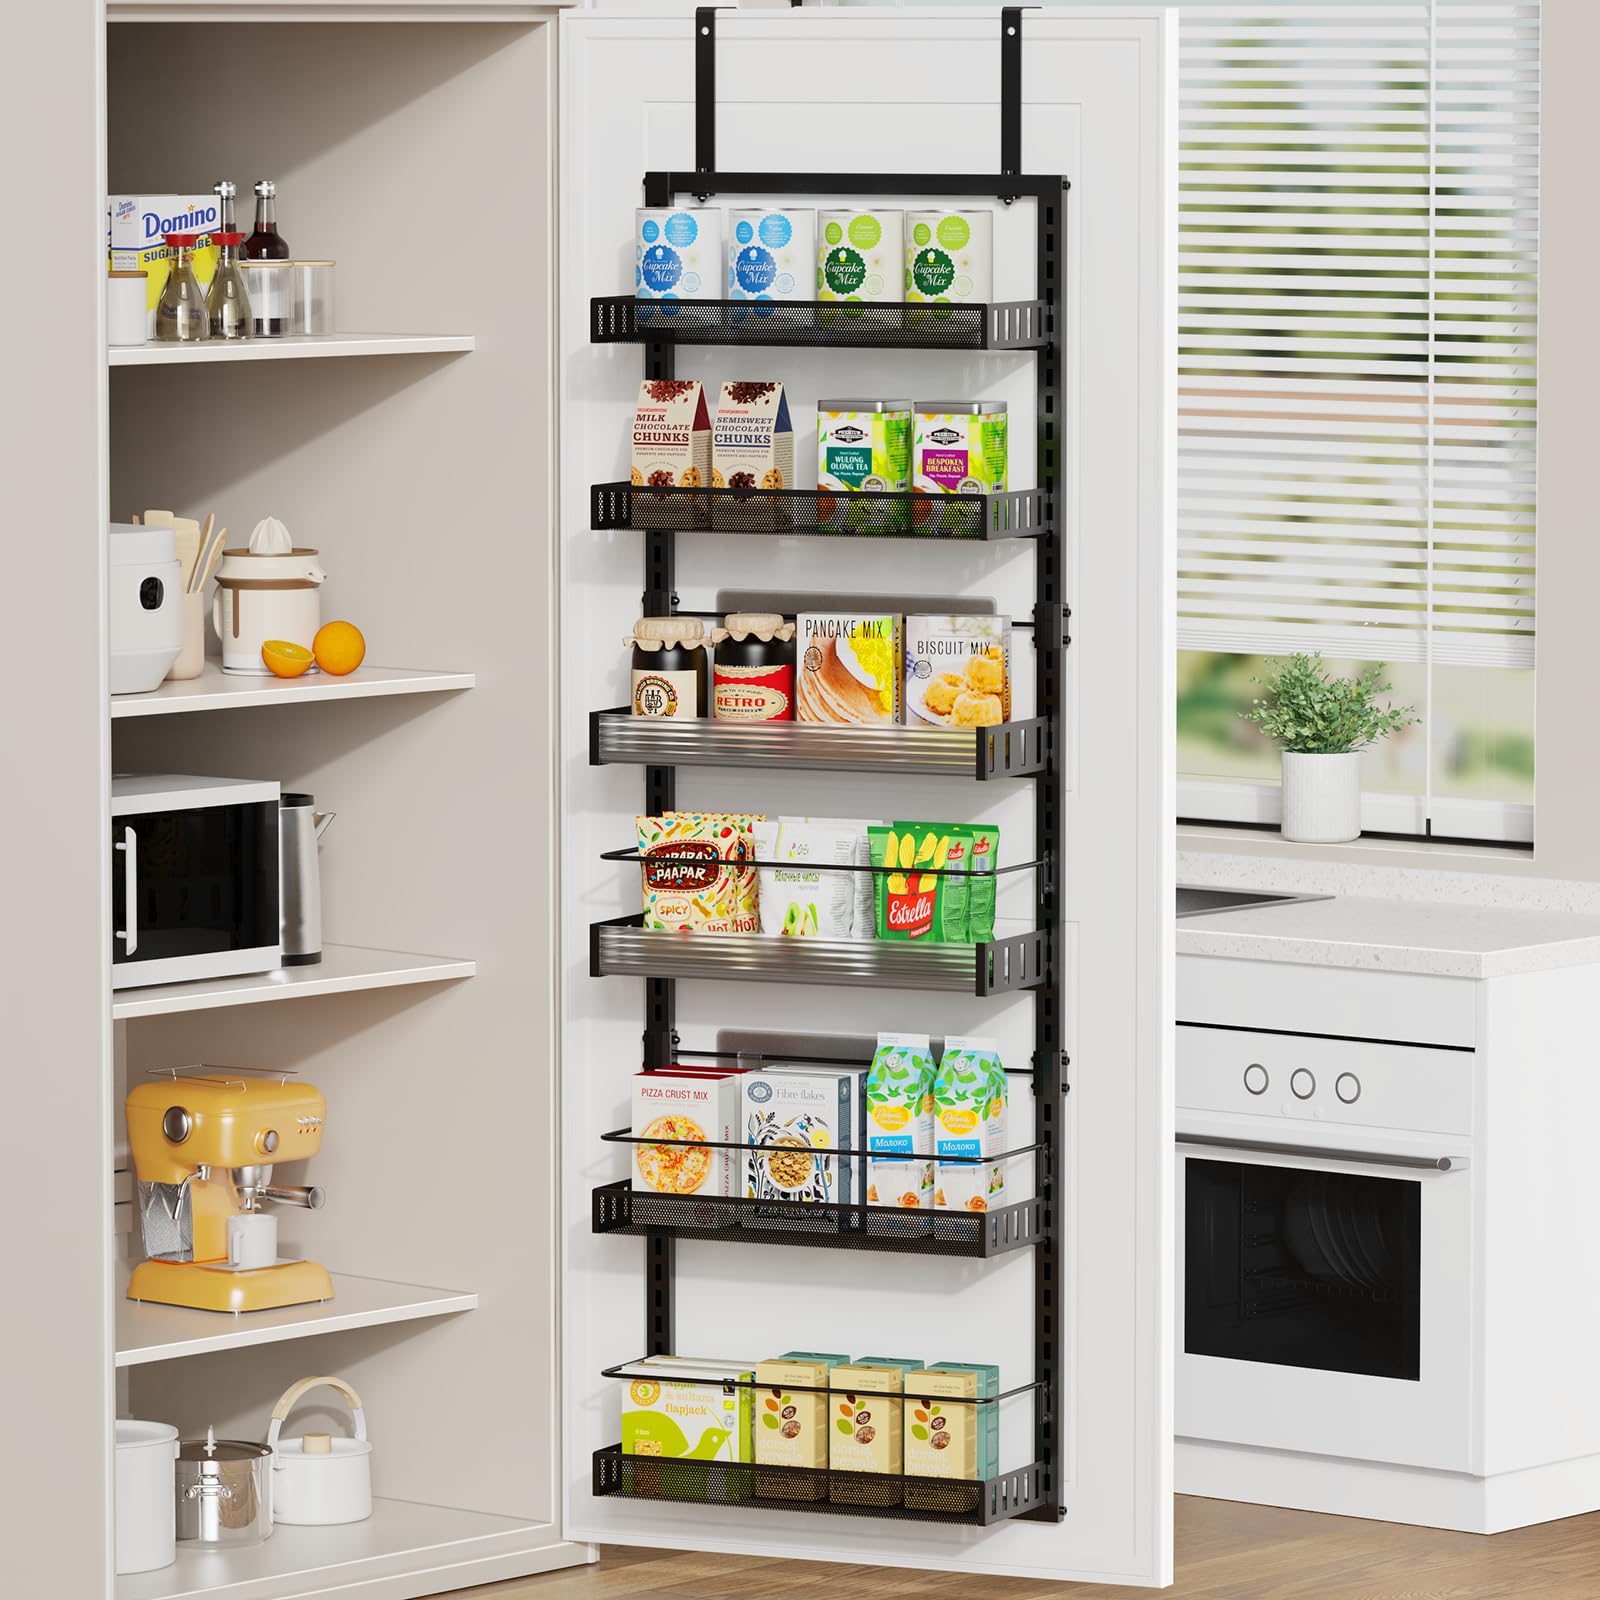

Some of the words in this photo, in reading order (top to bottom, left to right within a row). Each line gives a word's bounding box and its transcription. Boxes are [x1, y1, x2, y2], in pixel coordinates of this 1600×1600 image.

[142, 205, 217, 238] Domino
[144, 246, 179, 262] SUGAR
[644, 259, 679, 272] Cupcake
[738, 260, 773, 273] Cupcake
[826, 261, 862, 274] Cupcake
[914, 262, 952, 274] Cupcake
[652, 271, 675, 282] Mix
[745, 272, 769, 284] Mix
[834, 273, 858, 286] Mix
[924, 274, 947, 286] Mix
[636, 414, 666, 422] MILK
[716, 416, 774, 424] SEMISWEET
[633, 432, 689, 442] CHUNKS
[714, 434, 770, 444] CHUNKS
[928, 458, 964, 466] BESPOKEN
[806, 620, 856, 638] PANCAKE
[863, 620, 883, 639] MIX
[918, 640, 964, 655] BISCUIT
[970, 642, 990, 656] MIX
[717, 696, 765, 707] RETRO
[656, 866, 706, 881] PAAPAR
[660, 905, 688, 916] SPICY
[890, 896, 931, 924] Estrella
[735, 918, 755, 932] HOT
[642, 1088, 663, 1098] PIZZA
[666, 1090, 692, 1100] CRUST
[694, 1091, 708, 1100] MIX
[776, 1088, 798, 1099] Fibre
[800, 1089, 825, 1100] flakes
[876, 1138, 908, 1148] Молоко
[942, 1142, 976, 1152] Молоко
[665, 1403, 707, 1416] flapjack
